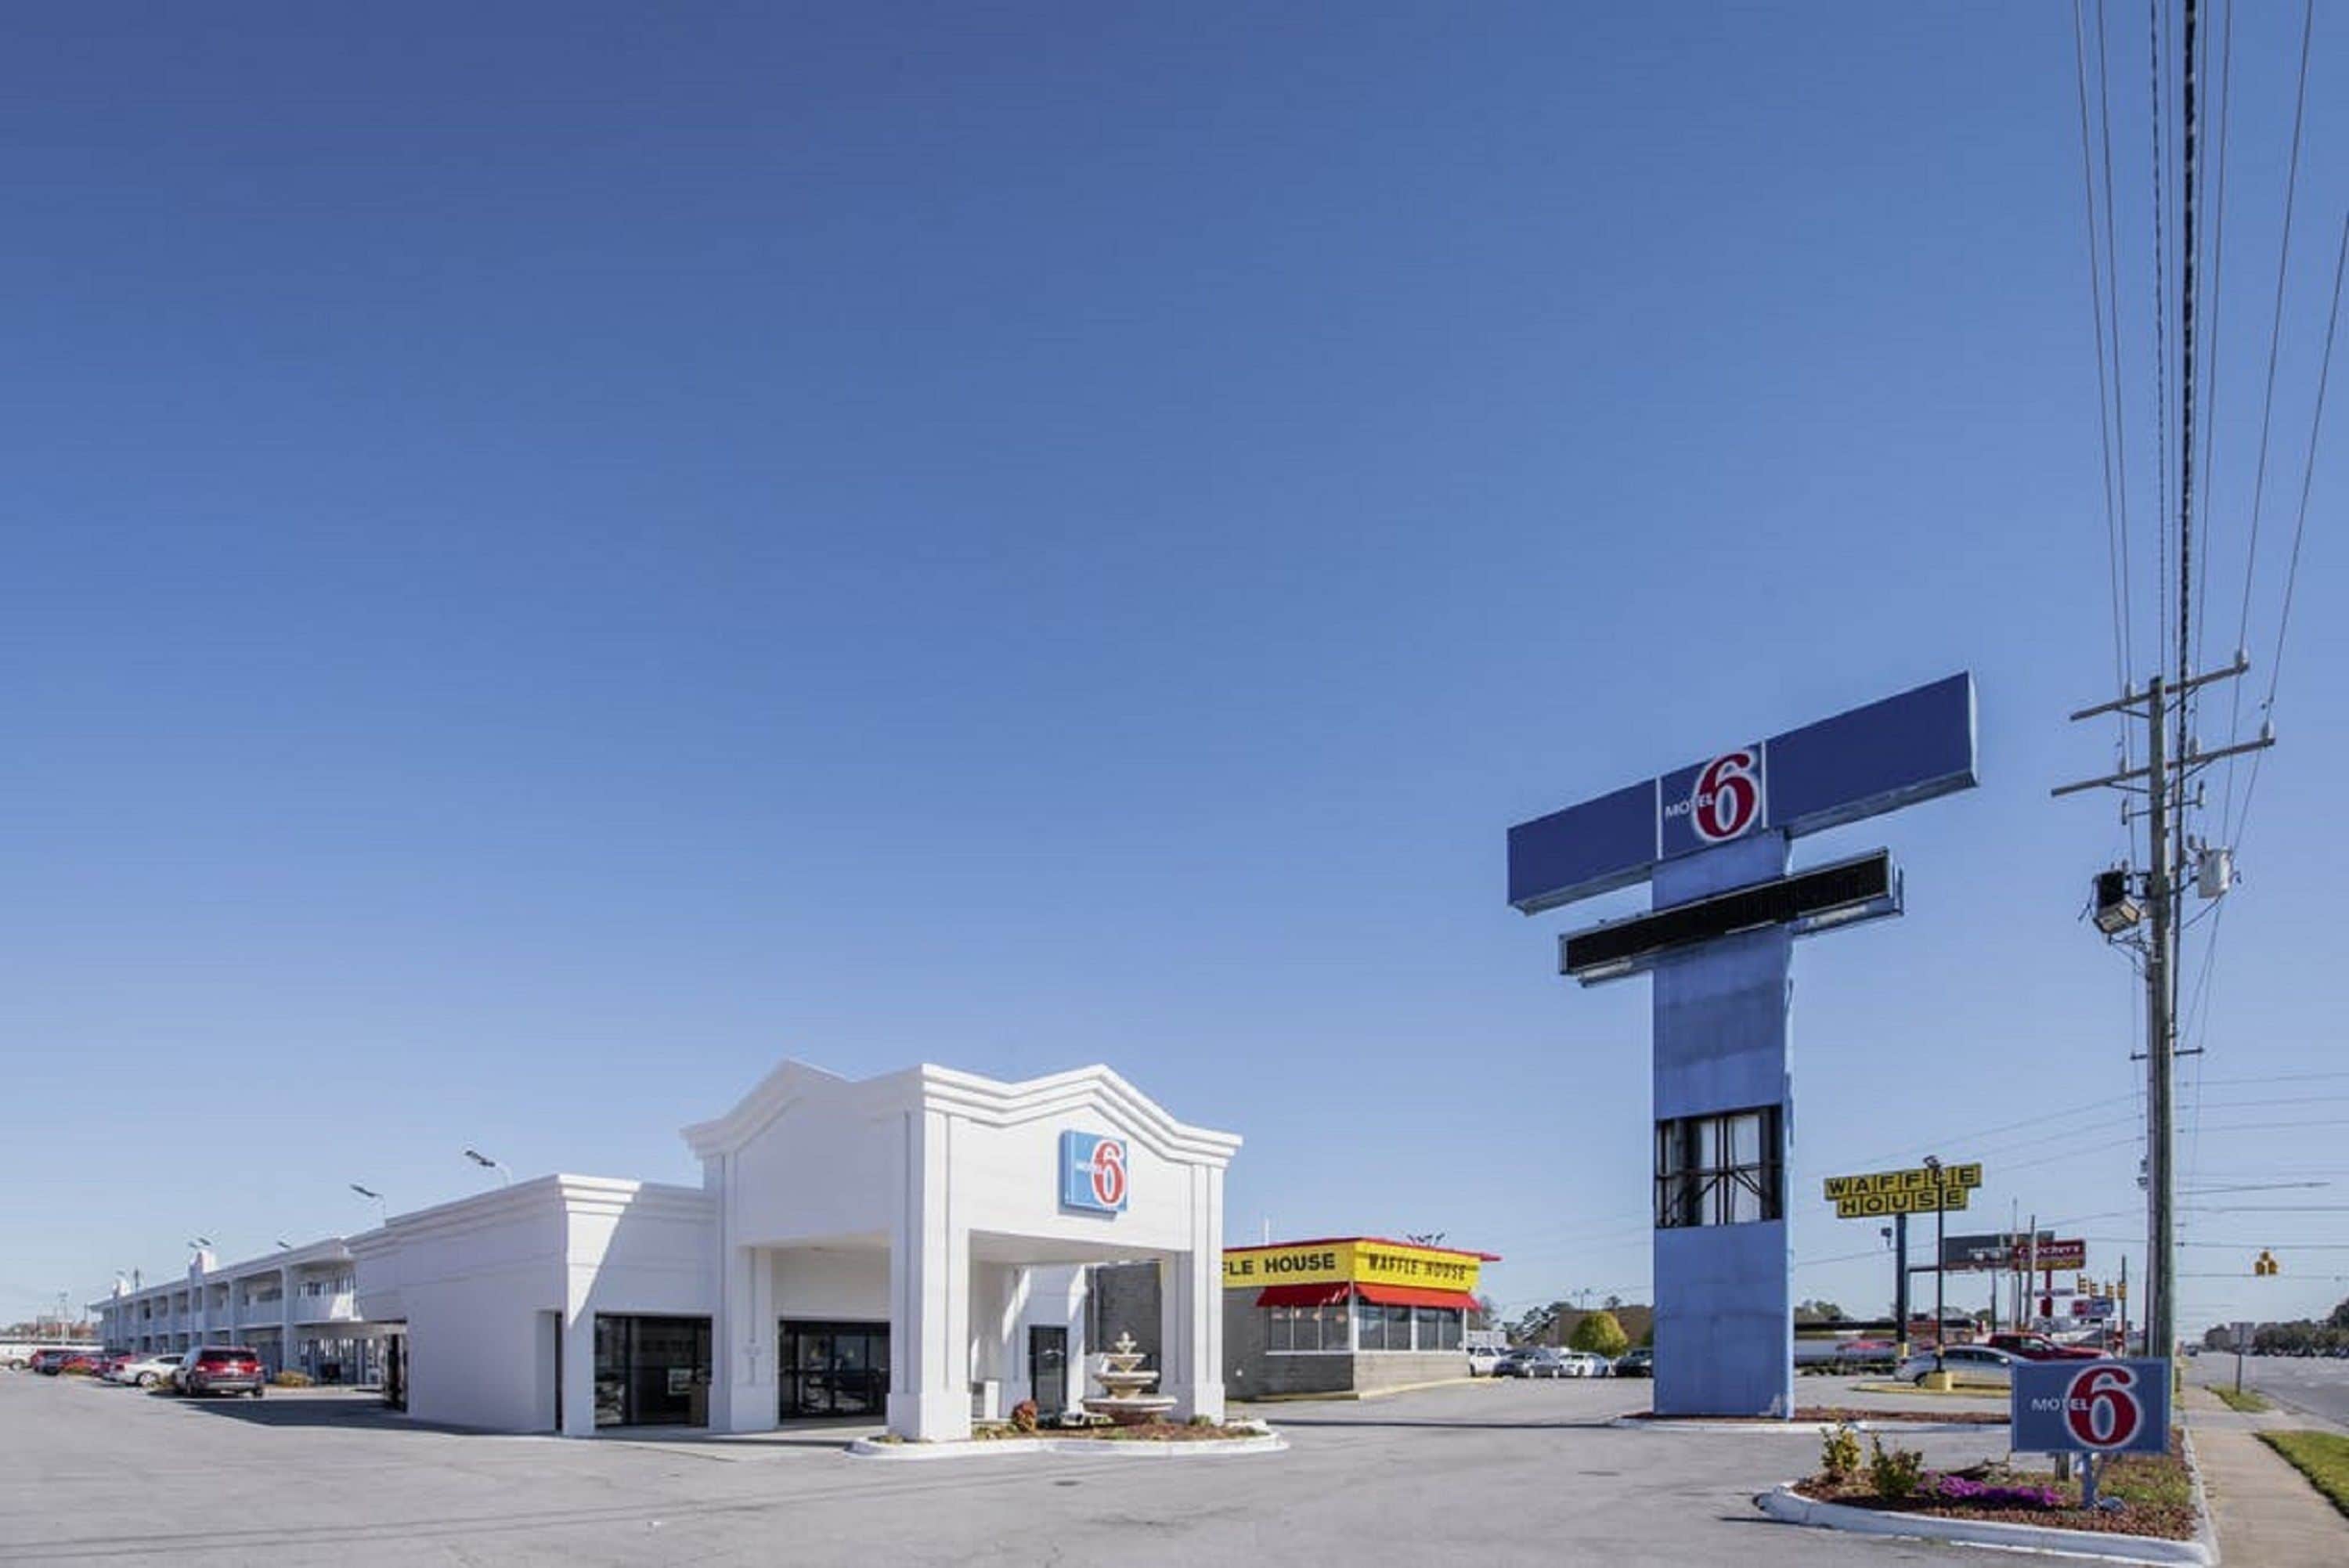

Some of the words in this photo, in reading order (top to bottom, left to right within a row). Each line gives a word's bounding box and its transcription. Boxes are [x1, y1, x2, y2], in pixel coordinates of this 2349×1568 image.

[1693, 752, 1759, 841] 6
[1092, 1140, 1125, 1206] 6
[1828, 1166, 1975, 1194] WAFFLE
[1842, 1189, 1963, 1213] HOUSE
[1265, 1253, 1336, 1273] HOUSE
[1369, 1253, 1418, 1275] WAFFLE
[1424, 1261, 1467, 1281] HOUSE
[2032, 1398, 2092, 1411] MOTEL
[2066, 1364, 2142, 1448] 6
